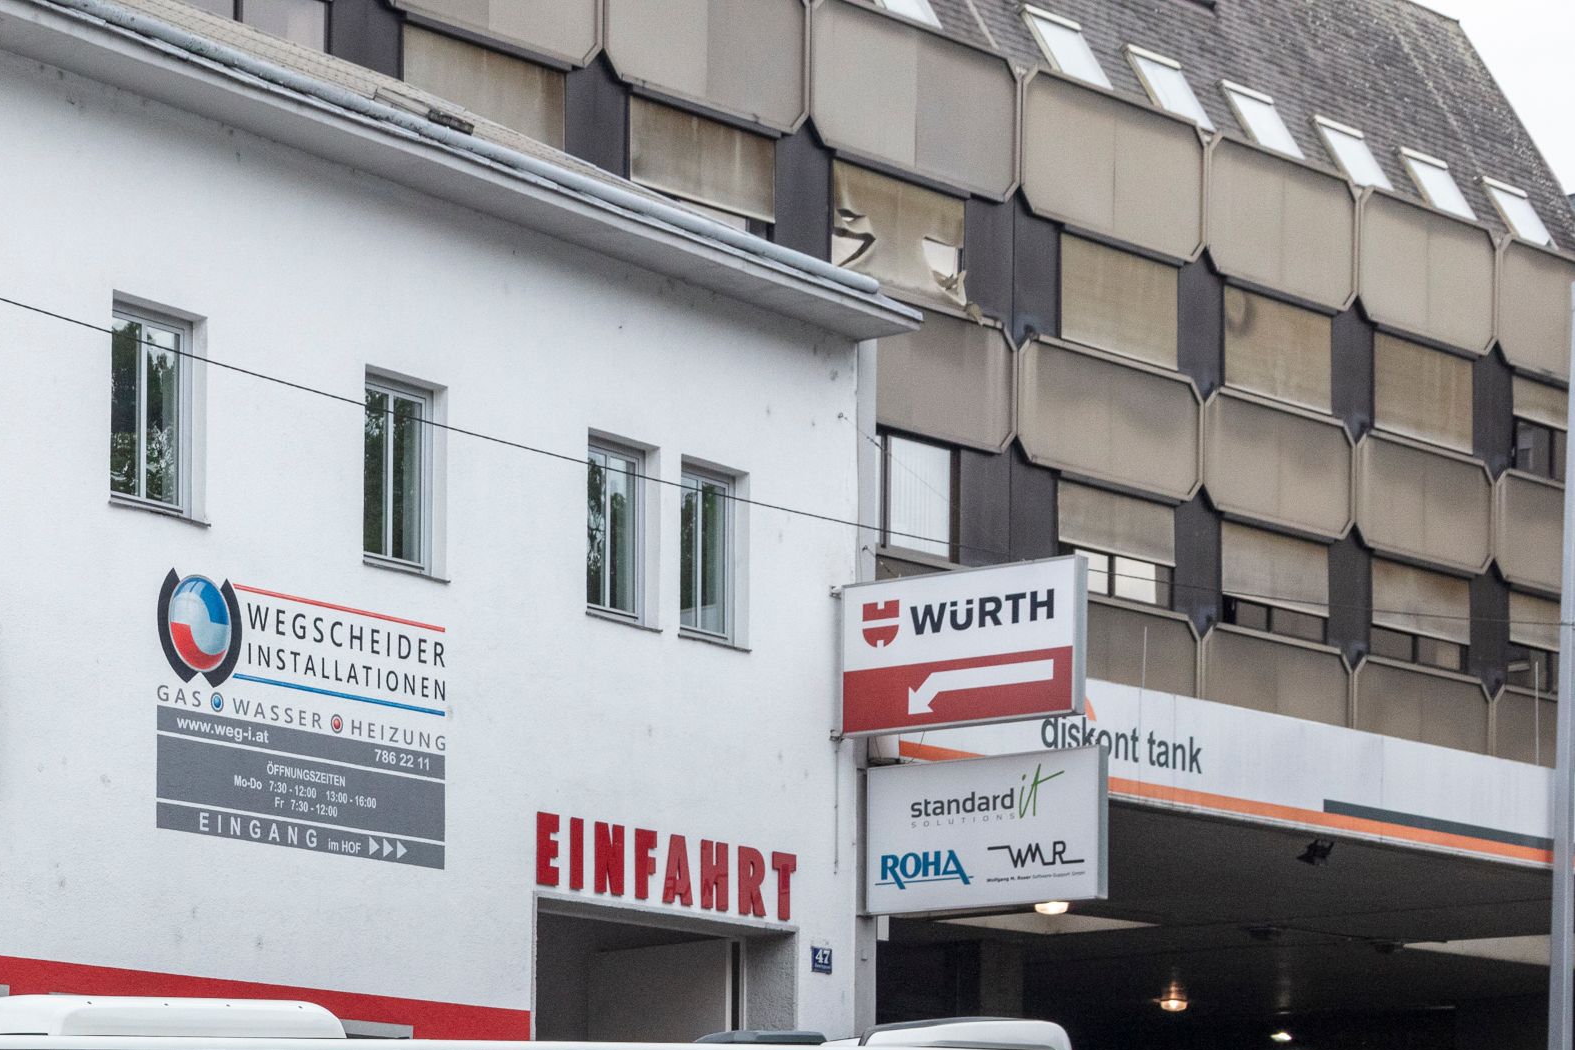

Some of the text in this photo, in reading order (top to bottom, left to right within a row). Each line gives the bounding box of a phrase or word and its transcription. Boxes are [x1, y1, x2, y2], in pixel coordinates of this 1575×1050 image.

[247, 602, 446, 668] WEGSCHEIDER
[247, 642, 446, 701] INSTALLATIONEN
[156, 684, 446, 751] GAS WASSER HEIZUNG
[177, 717, 431, 771] www.weg-i.at 786 22 11
[1041, 716, 1203, 775] diskont tank
[234, 774, 263, 790] Mo-Do
[269, 780, 288, 794] 7:30
[294, 784, 317, 799] 12:00
[326, 790, 348, 804] 13:00
[355, 795, 377, 809] 16:00
[266, 760, 346, 787] ÖFFNUNGSZEITEN
[274, 796, 285, 809] Fr
[290, 799, 309, 813] 7:30
[316, 803, 338, 818] 12:00
[910, 787, 1015, 819] standard
[911, 811, 1016, 829] SOLUTIONS
[199, 811, 362, 855] EINGANG im HOF
[535, 810, 797, 922] EINFAHRT
[879, 849, 972, 890] ROHA
[815, 949, 831, 965] 47
